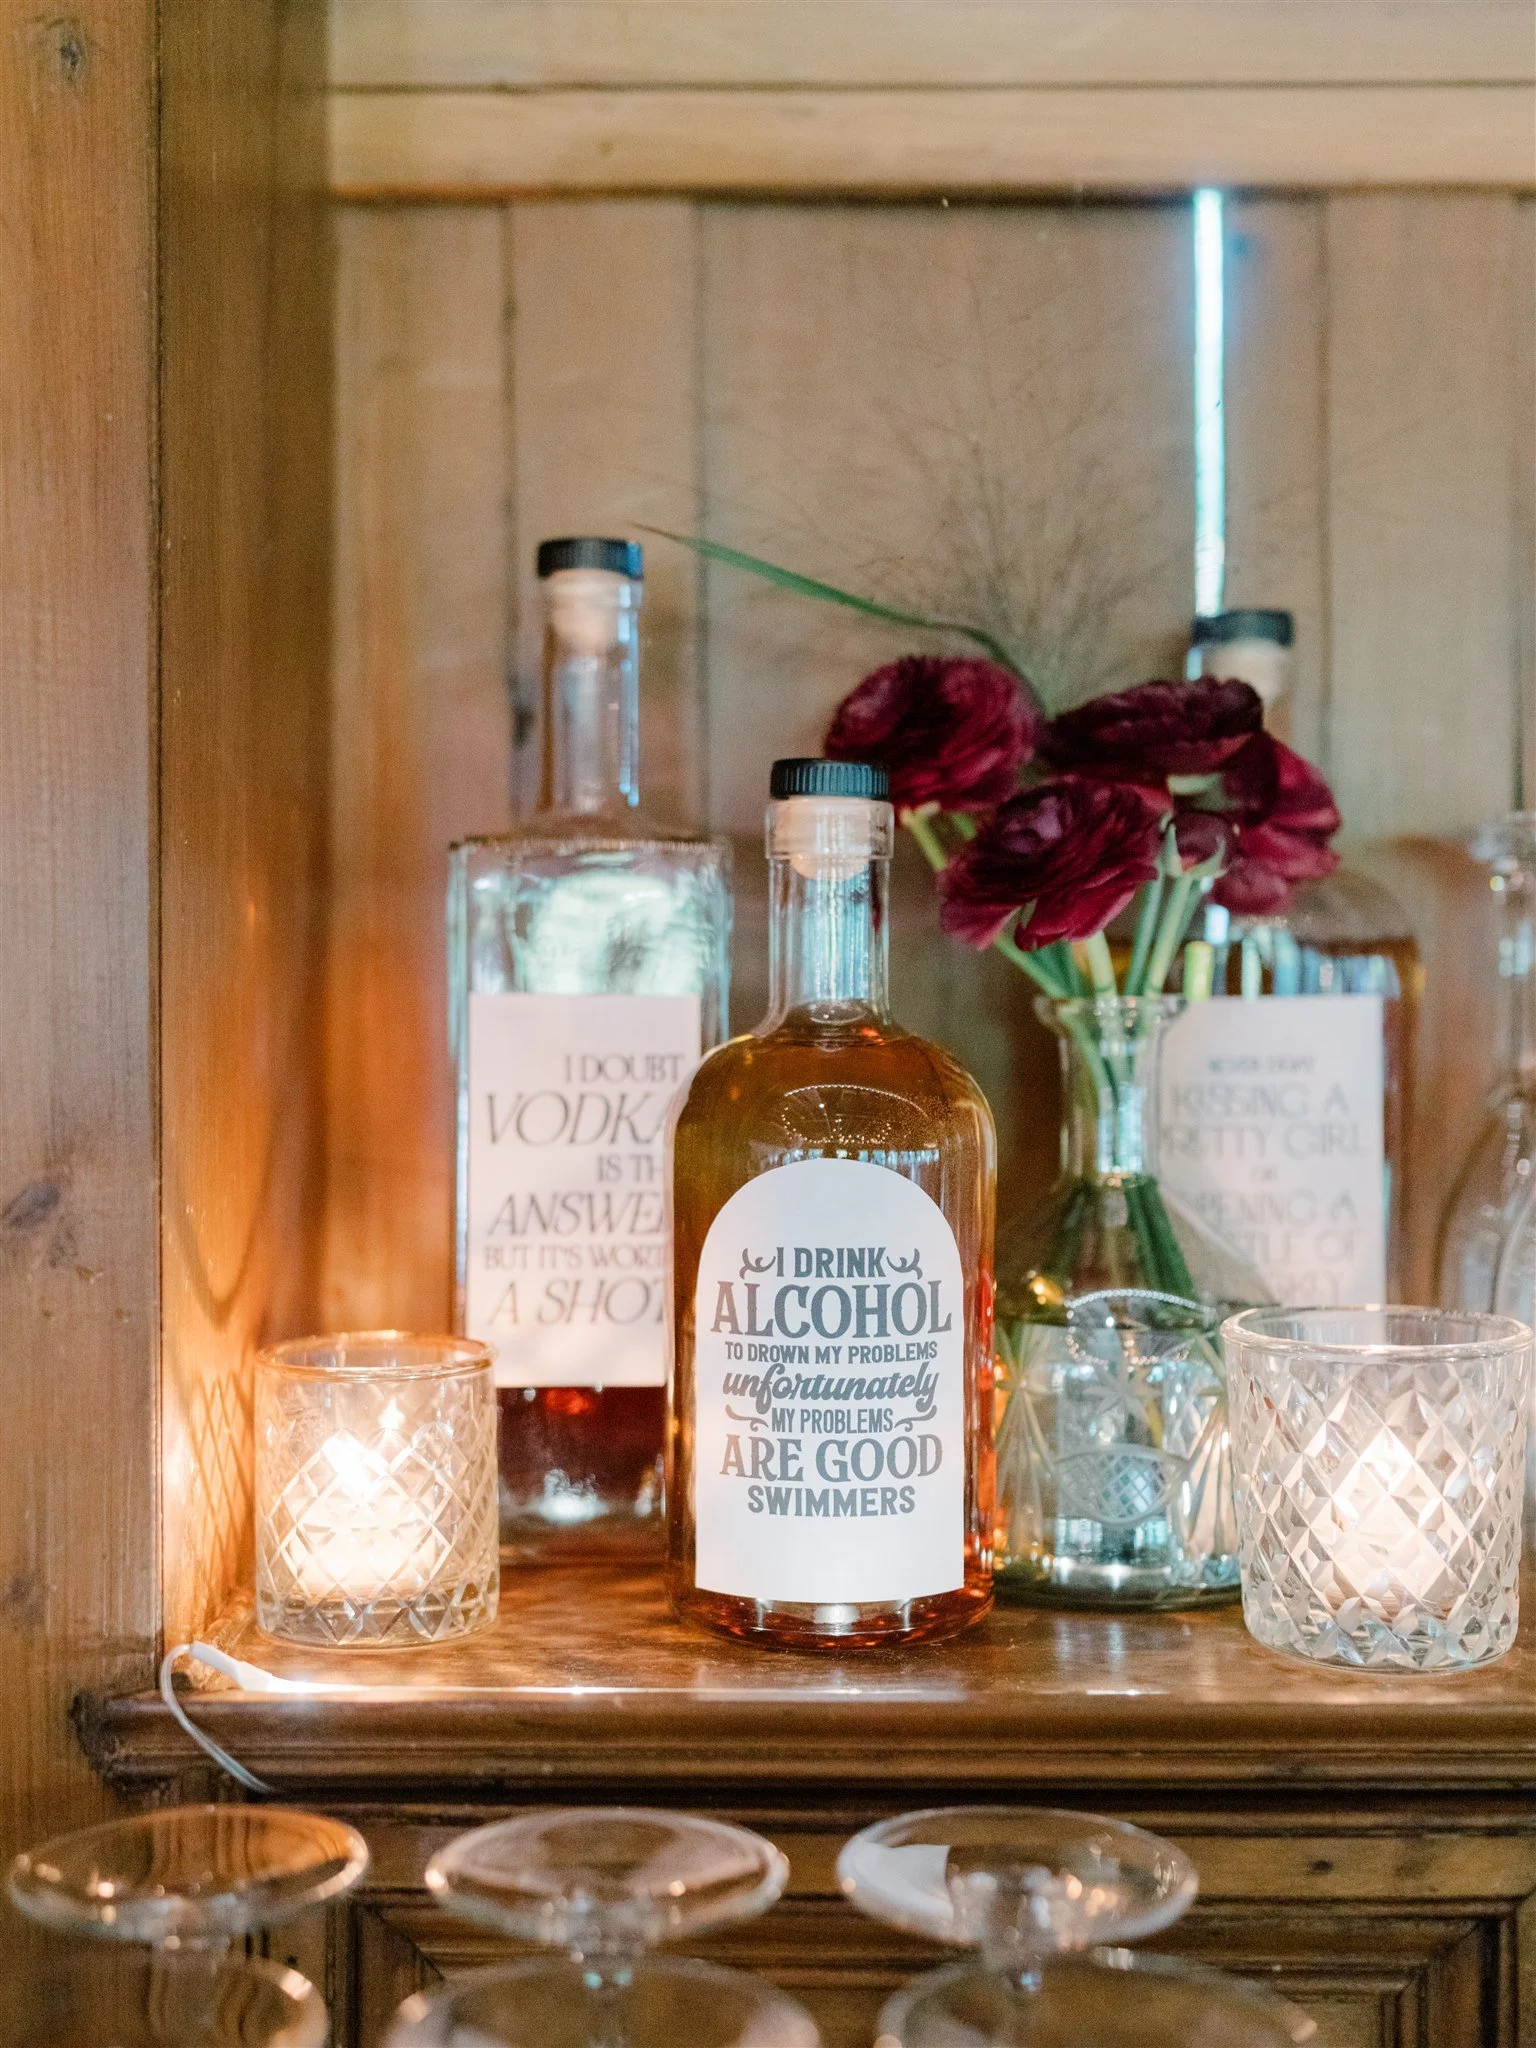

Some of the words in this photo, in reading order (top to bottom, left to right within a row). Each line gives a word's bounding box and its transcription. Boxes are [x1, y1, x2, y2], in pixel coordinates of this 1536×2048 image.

[564, 1054, 575, 1083] I
[580, 1053, 685, 1083] DOUBT
[598, 1153, 622, 1183] IS
[487, 1190, 664, 1237] ANSWE
[483, 1243, 532, 1271] BUT
[538, 1243, 582, 1271] IT'S
[588, 1243, 664, 1270] WORT
[776, 1247, 785, 1277] I
[794, 1247, 887, 1278] DRINK
[487, 1280, 520, 1326] A
[710, 1280, 952, 1339] ALCOHOL
[725, 1341, 743, 1360] TO
[747, 1343, 810, 1364] DROWN
[815, 1345, 843, 1364] MY
[848, 1341, 938, 1364] PROBLEMS
[722, 1361, 940, 1415] unfortunately
[771, 1407, 796, 1433] MY
[800, 1407, 894, 1434] PROBLEMS
[719, 1433, 804, 1482] ARE
[815, 1433, 943, 1483] GOOD
[748, 1485, 916, 1517] SWIMMERS
